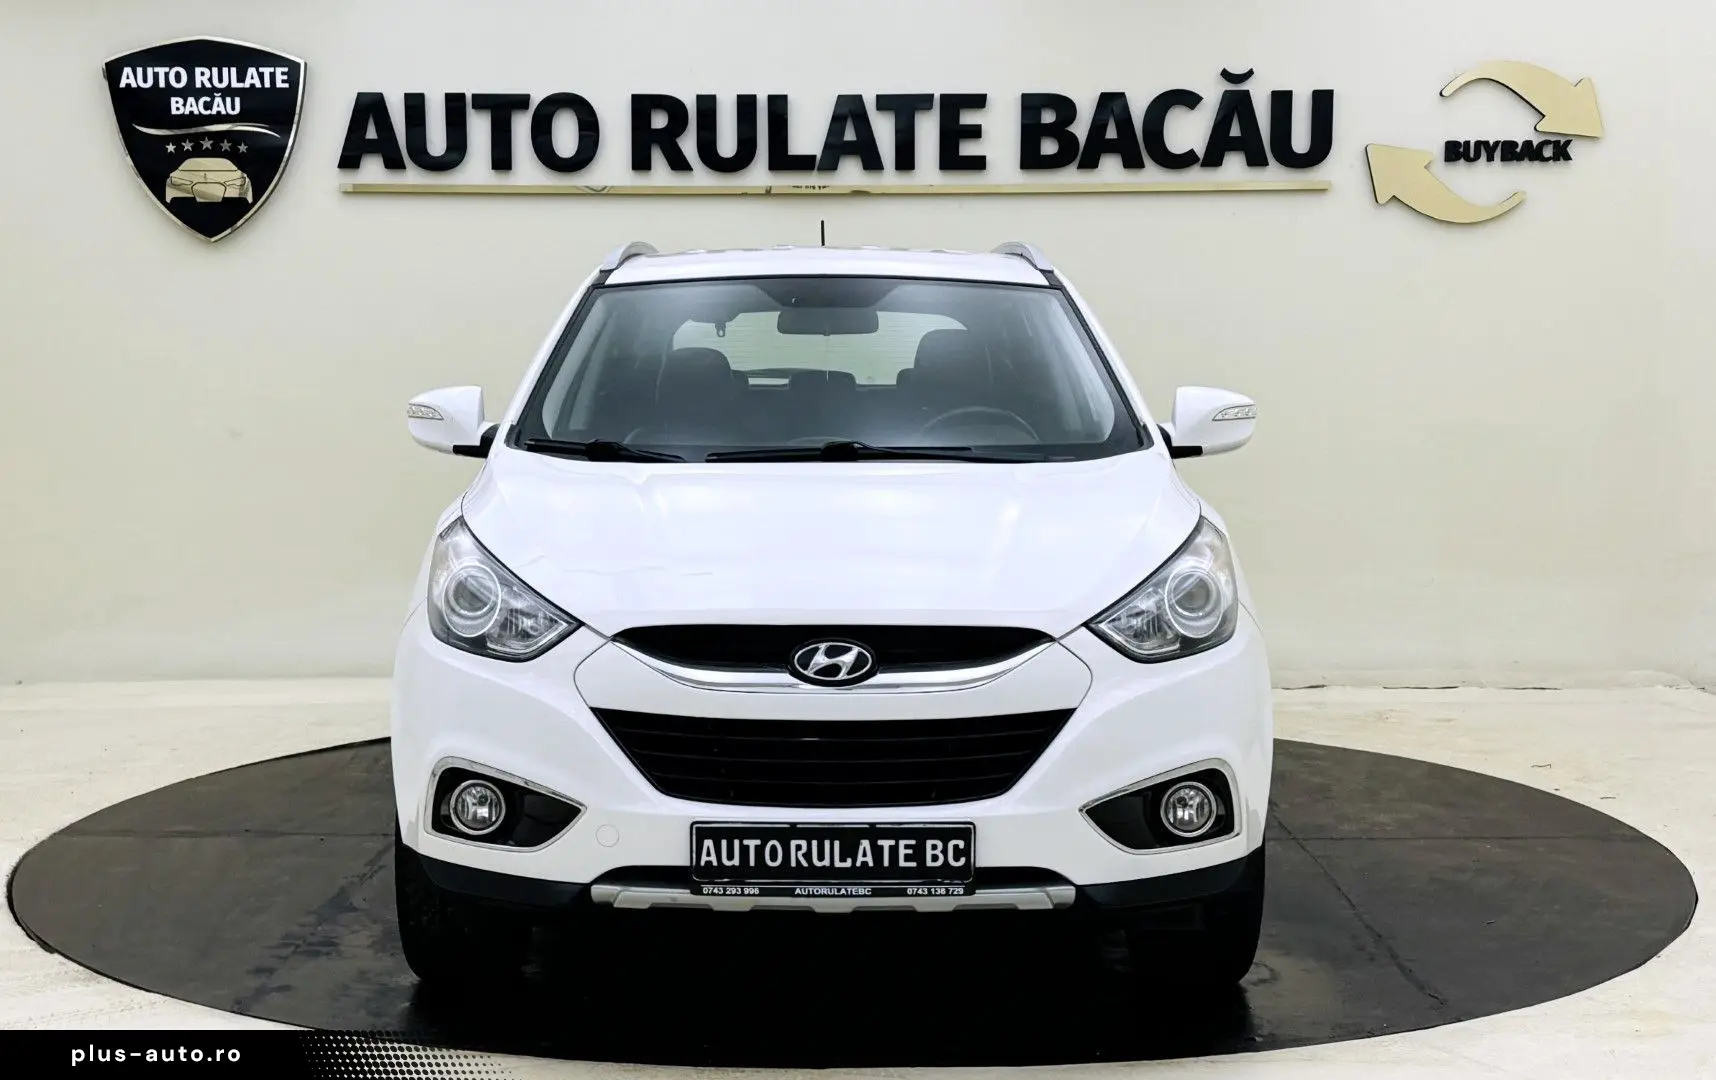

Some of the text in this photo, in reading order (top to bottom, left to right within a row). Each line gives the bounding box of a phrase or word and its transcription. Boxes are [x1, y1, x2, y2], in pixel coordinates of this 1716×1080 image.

[119, 66, 290, 89] AUTO RULATE
[170, 92, 241, 116] BACĂU
[337, 68, 1335, 173] AUTO RULATE BACĂU
[1444, 139, 1573, 162] BUYBACK
[700, 839, 966, 867] AUTO RULATE BC
[702, 887, 724, 895] 0743
[725, 887, 742, 895] 293
[794, 887, 872, 896] AUTORULATEBC
[906, 887, 928, 896] 0743
[948, 887, 964, 896] 729
